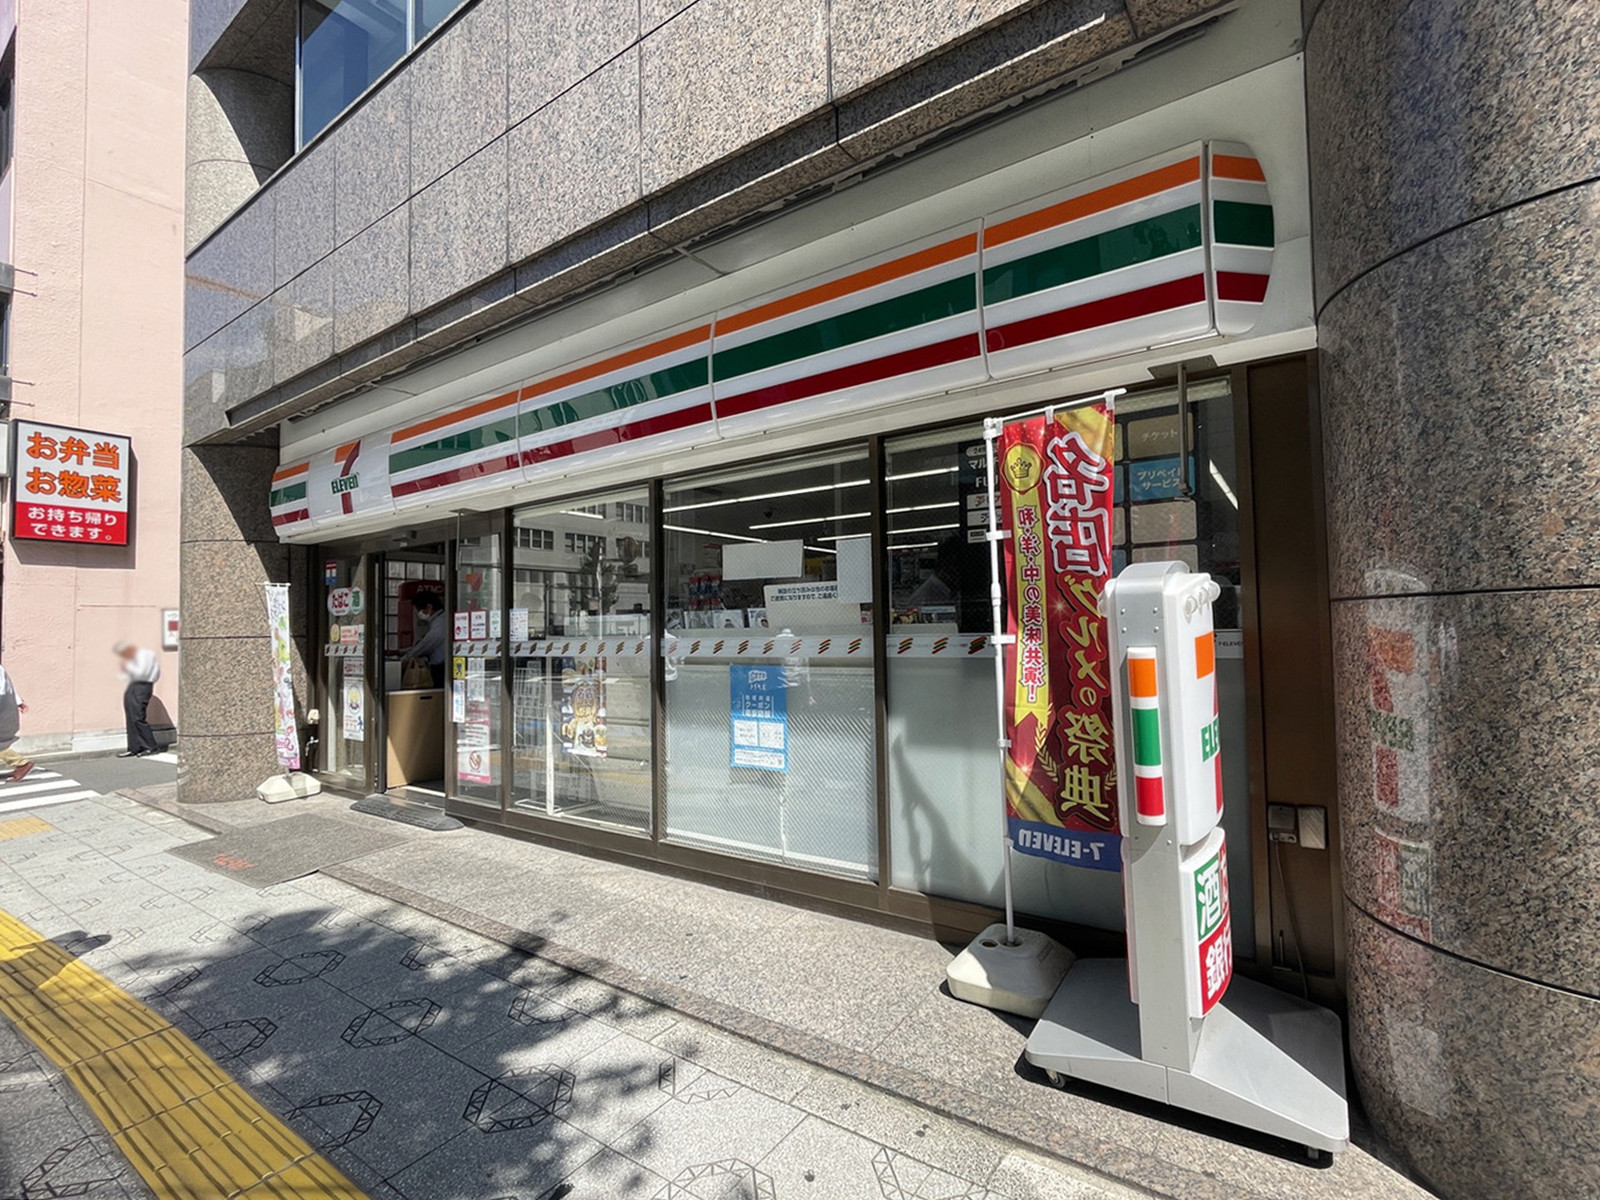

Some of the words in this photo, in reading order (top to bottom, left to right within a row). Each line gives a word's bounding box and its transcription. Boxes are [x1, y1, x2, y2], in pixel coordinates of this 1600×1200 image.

[1140, 429, 1178, 441] チケット
[26, 431, 120, 470] お弁当
[25, 466, 122, 503] お惣菜
[28, 506, 118, 526] お持ち帰り
[30, 523, 112, 540] できます。
[1197, 858, 1222, 936] 酒
